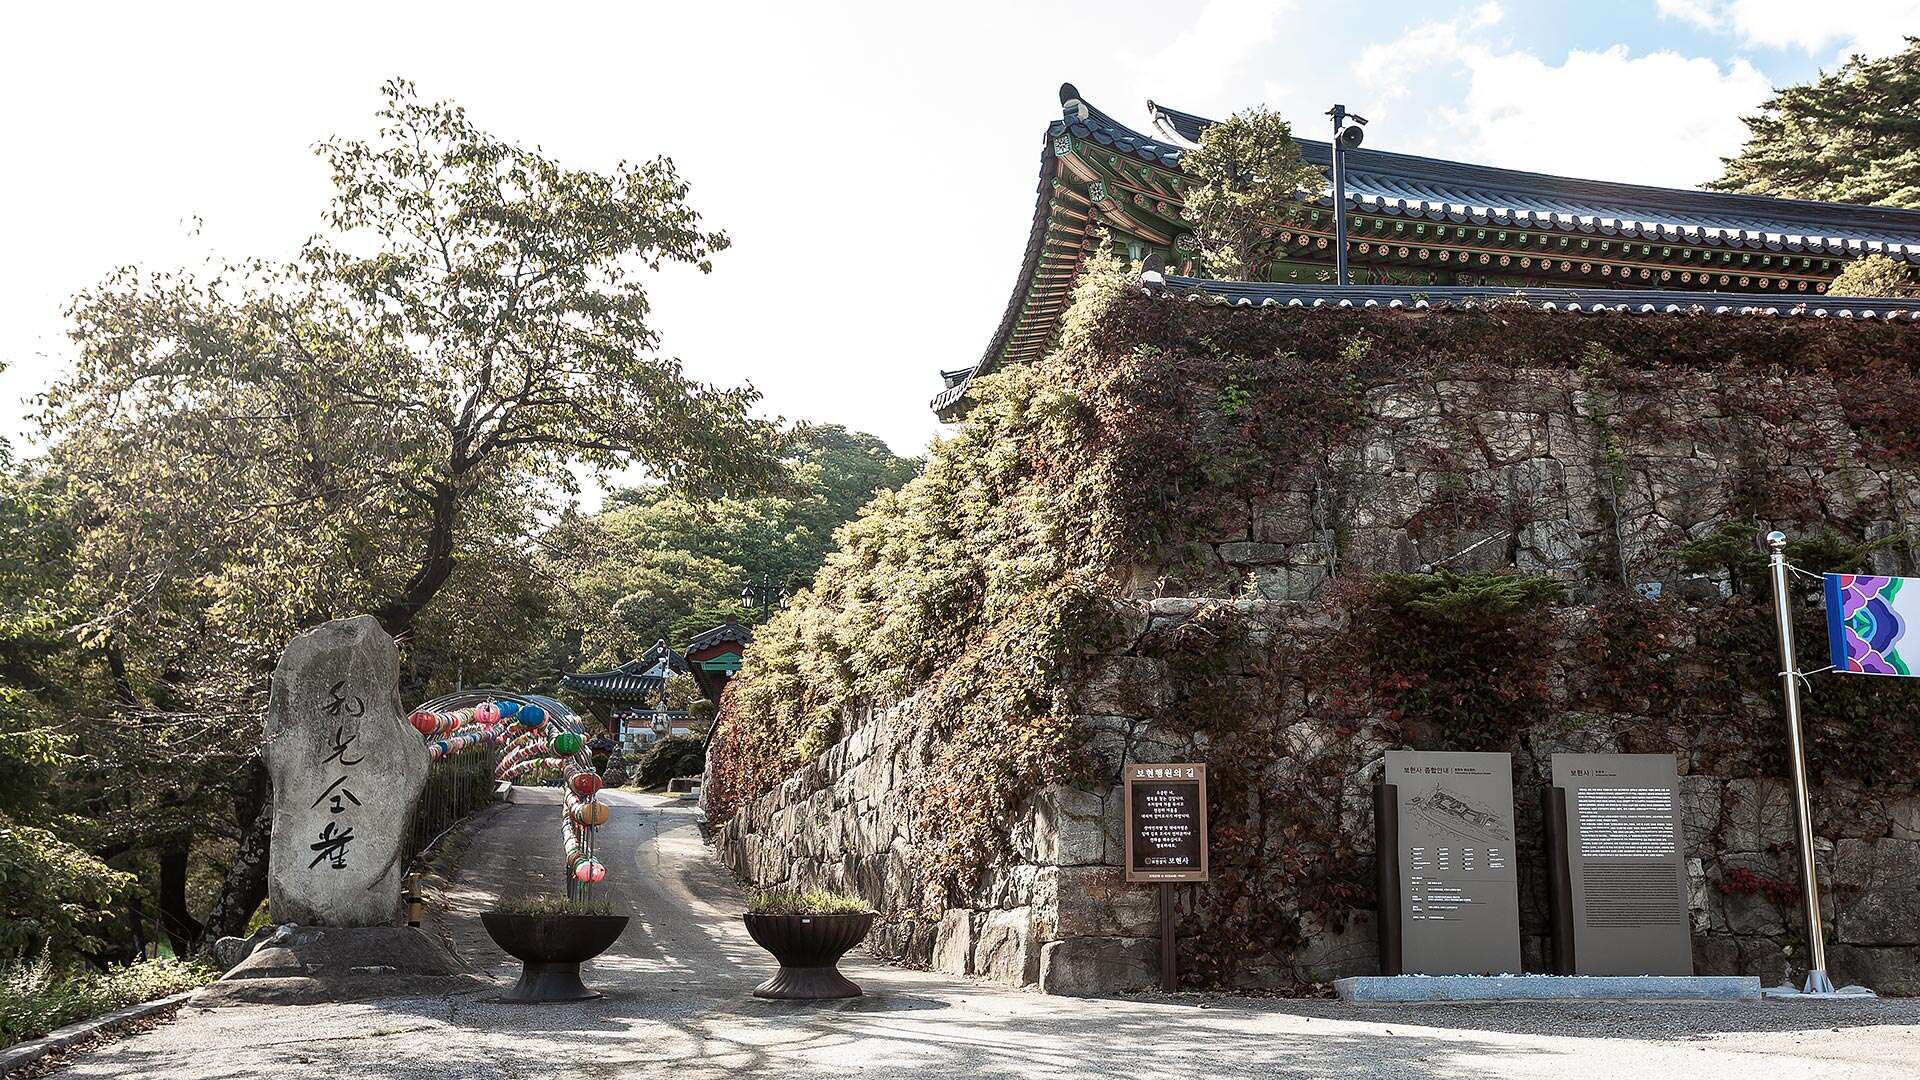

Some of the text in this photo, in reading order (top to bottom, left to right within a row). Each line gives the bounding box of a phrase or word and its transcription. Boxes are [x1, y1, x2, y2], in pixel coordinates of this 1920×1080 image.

[1136, 768, 1194, 778] 보현행원의 길
[1168, 857, 1189, 865] 보현사
